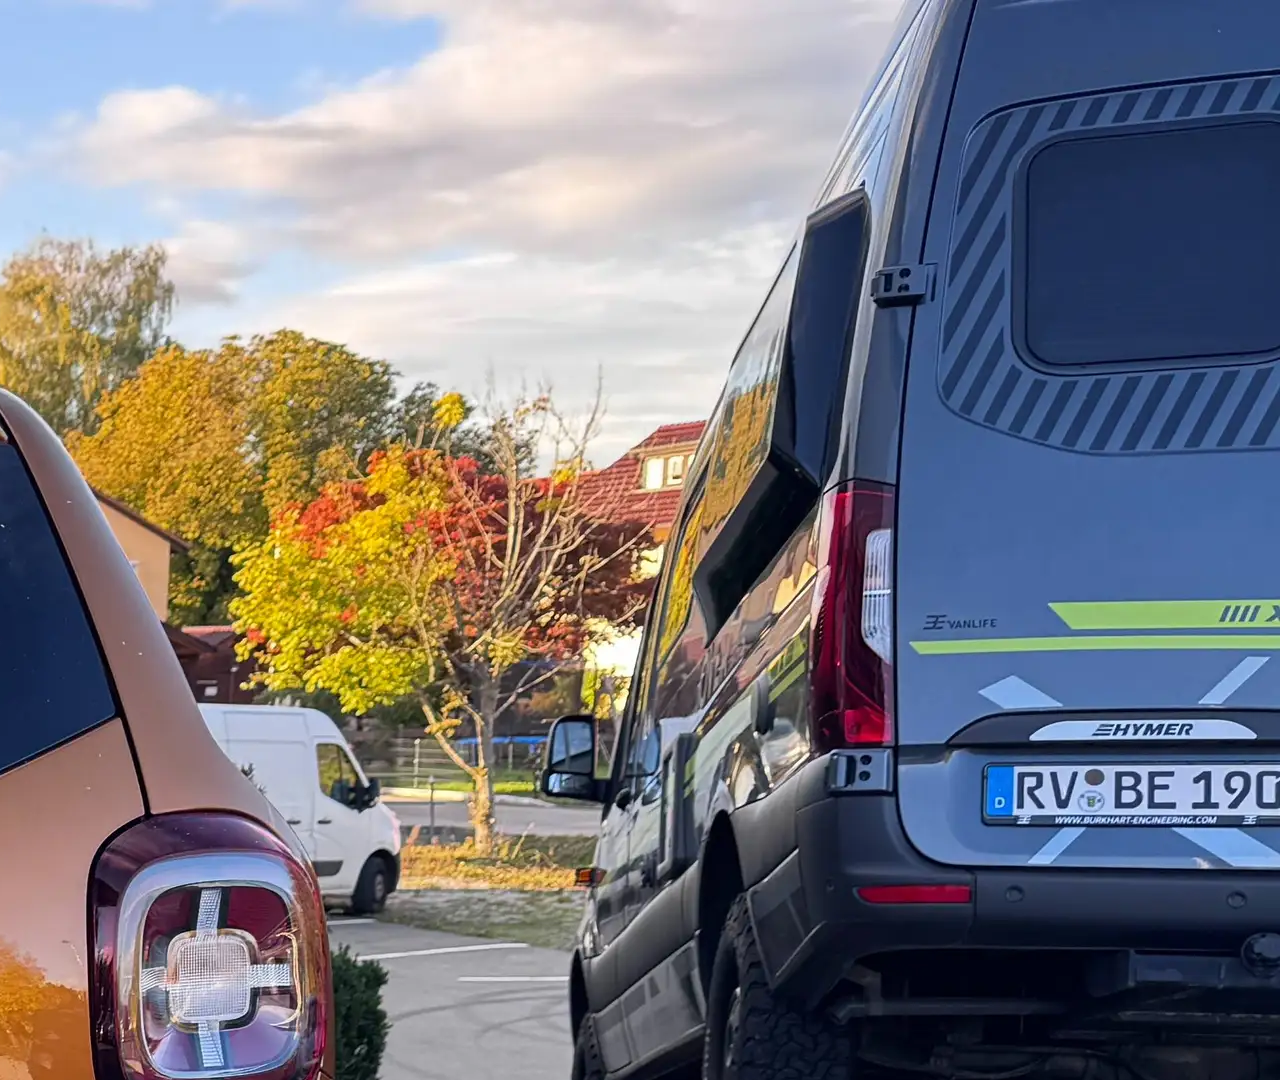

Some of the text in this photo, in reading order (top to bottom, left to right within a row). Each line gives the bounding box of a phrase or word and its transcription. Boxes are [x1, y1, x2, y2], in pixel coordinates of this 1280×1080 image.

[947, 618, 998, 629] VANLIFE
[1112, 723, 1194, 736] HYMER
[1016, 771, 1079, 809] RV
[1114, 771, 1177, 809] BE
[994, 796, 1005, 808] D
[1054, 816, 1217, 824] WWW.BURKHART-ENGINEERING.COM
